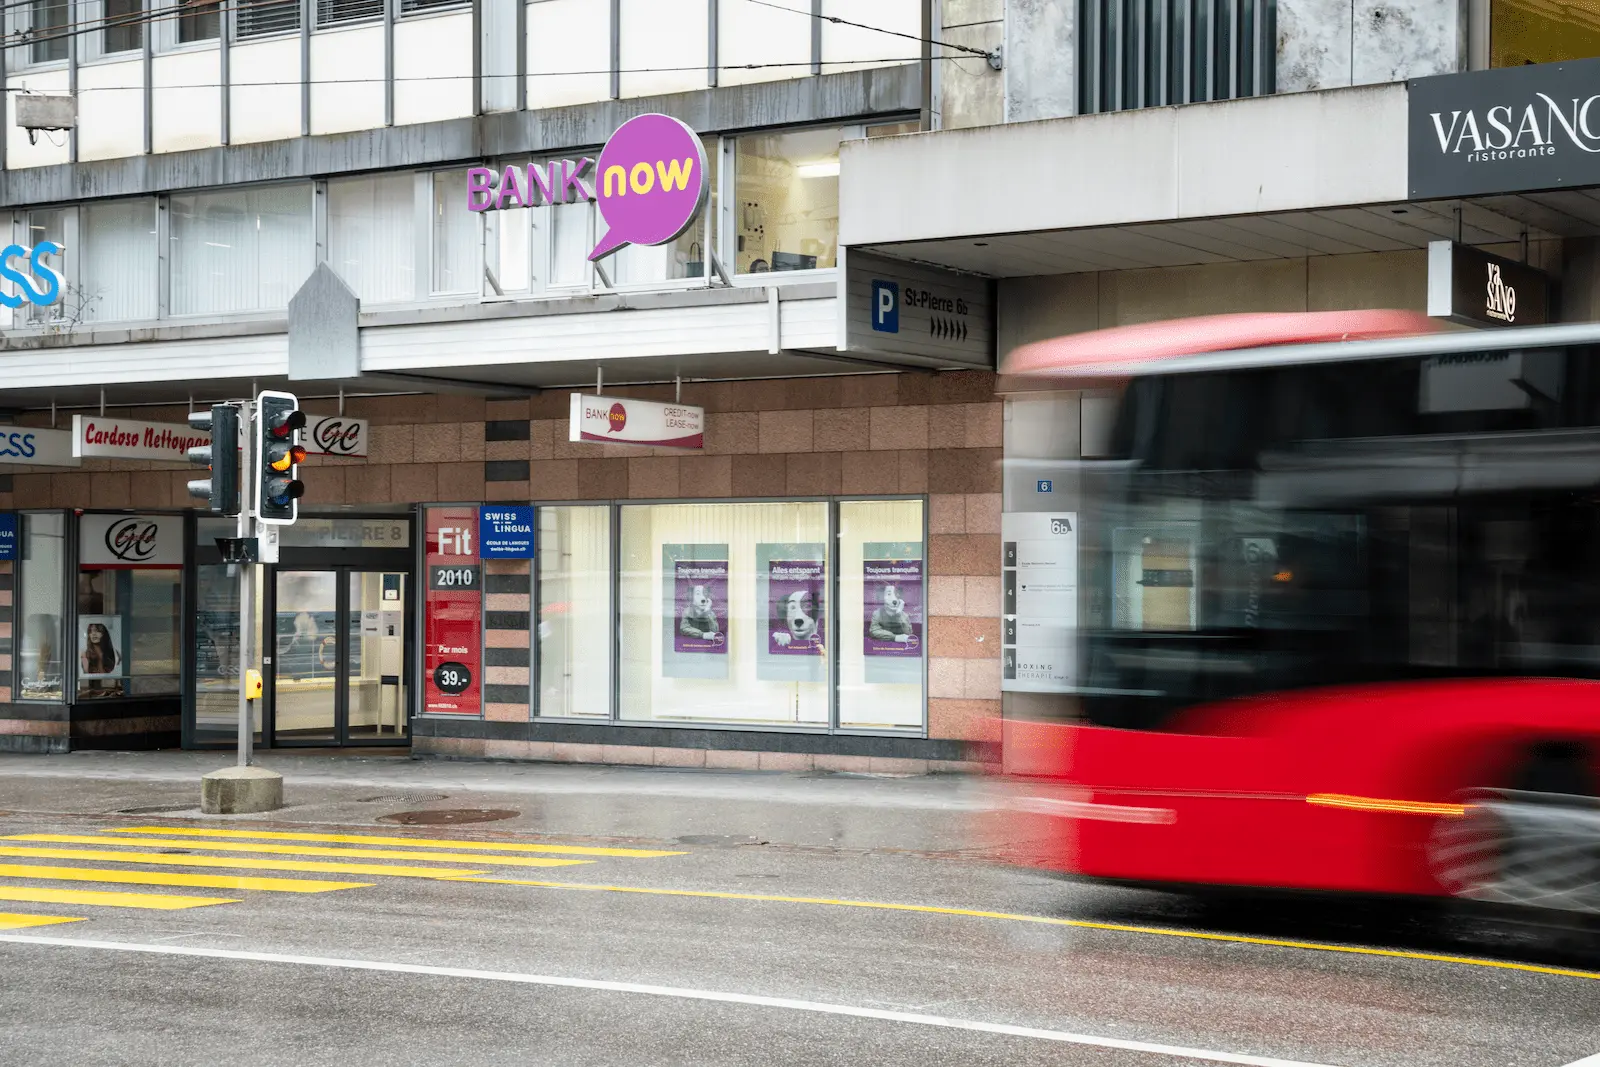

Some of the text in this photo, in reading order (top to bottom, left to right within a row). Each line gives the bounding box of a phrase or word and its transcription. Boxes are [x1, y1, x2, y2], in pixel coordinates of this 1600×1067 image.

[1467, 146, 1556, 163] ristorante
[467, 157, 693, 212] BANK now
[878, 287, 894, 324] P
[905, 288, 968, 316] St-Pierre 6b
[586, 408, 625, 421] BANK now
[85, 423, 213, 454] Cardoso Nettoyae
[1041, 482, 1048, 491] 6
[485, 512, 517, 521] SWISS
[0, 530, 14, 538] UA
[391, 526, 402, 541] 8
[494, 525, 531, 533] LINGUA
[1051, 519, 1069, 535] 6b
[438, 527, 472, 556] Fit
[1008, 550, 1014, 558] 5
[437, 569, 472, 586] 2010
[438, 645, 468, 654] Par mois
[441, 670, 467, 686] 39.-
[1018, 672, 1052, 680] THERAPIE
